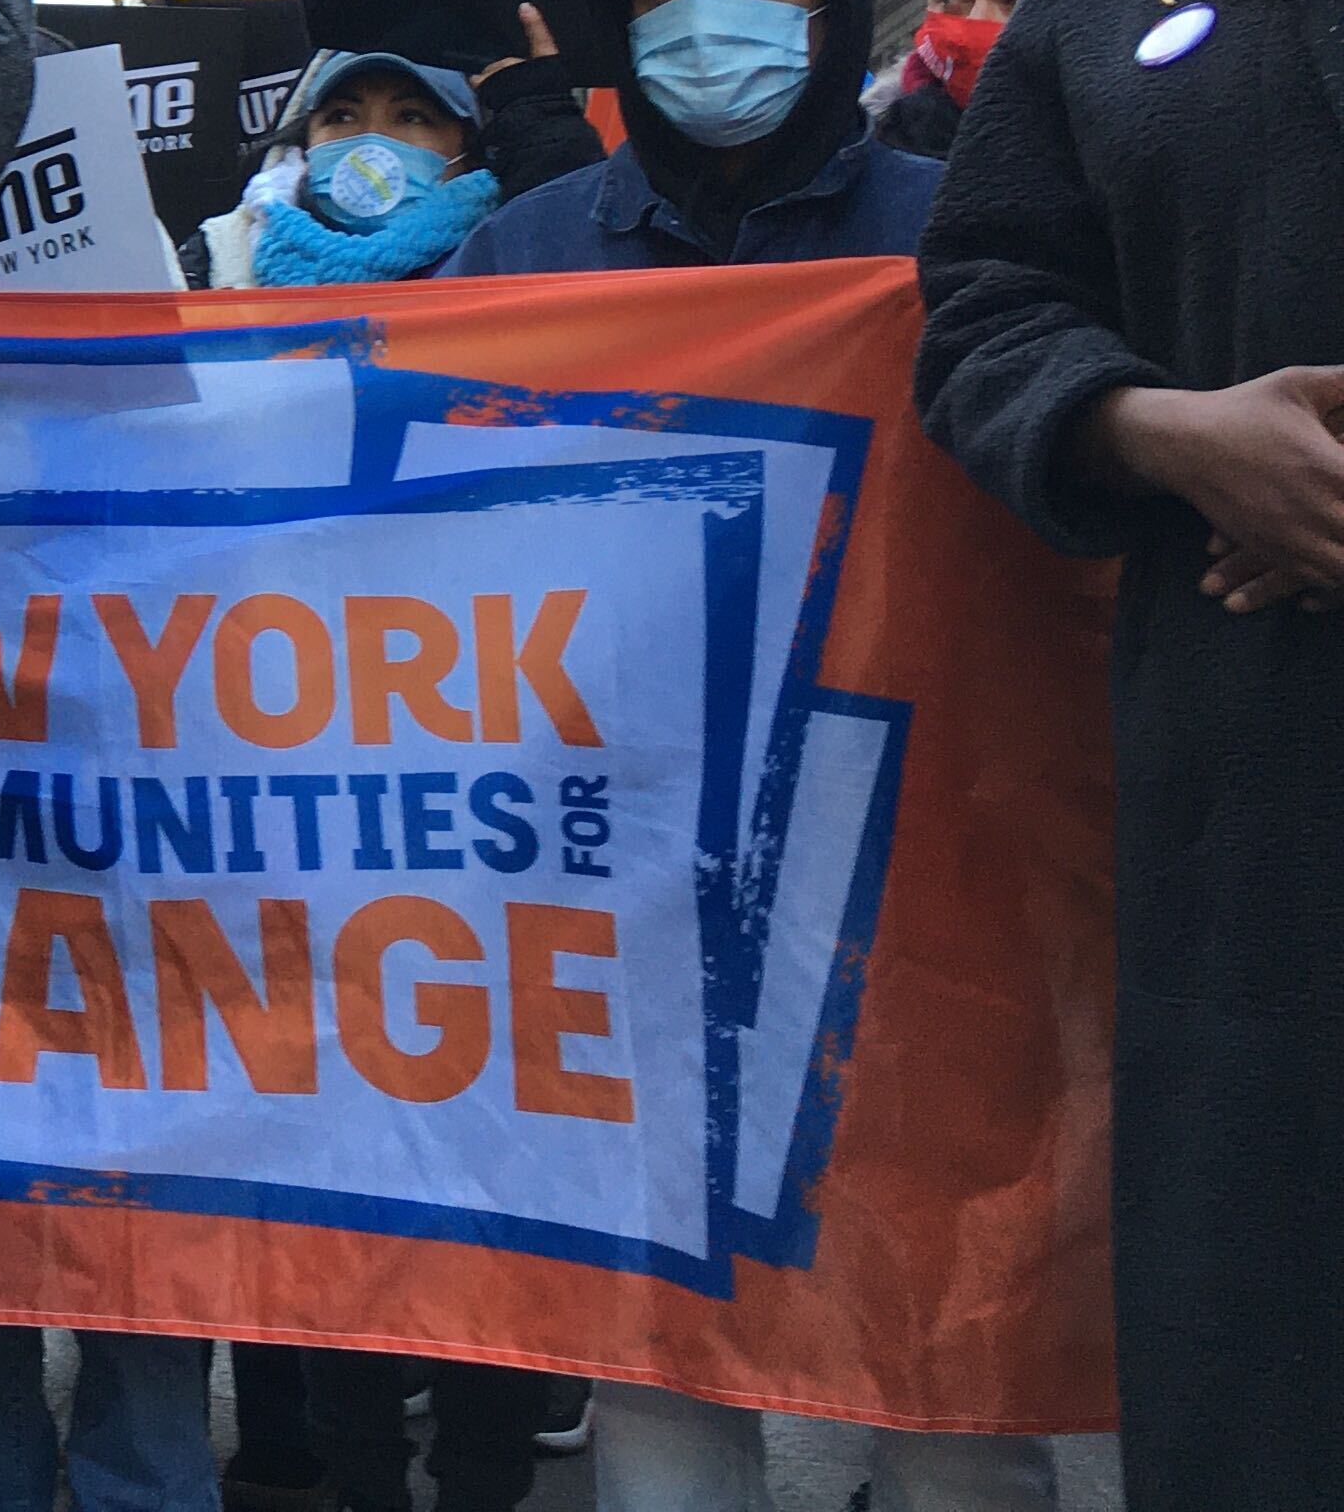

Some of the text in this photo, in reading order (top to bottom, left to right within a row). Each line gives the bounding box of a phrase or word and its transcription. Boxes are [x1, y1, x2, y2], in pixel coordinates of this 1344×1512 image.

[27, 225, 95, 265] YORK
[91, 588, 606, 750] YORK
[560, 774, 611, 879] FOR
